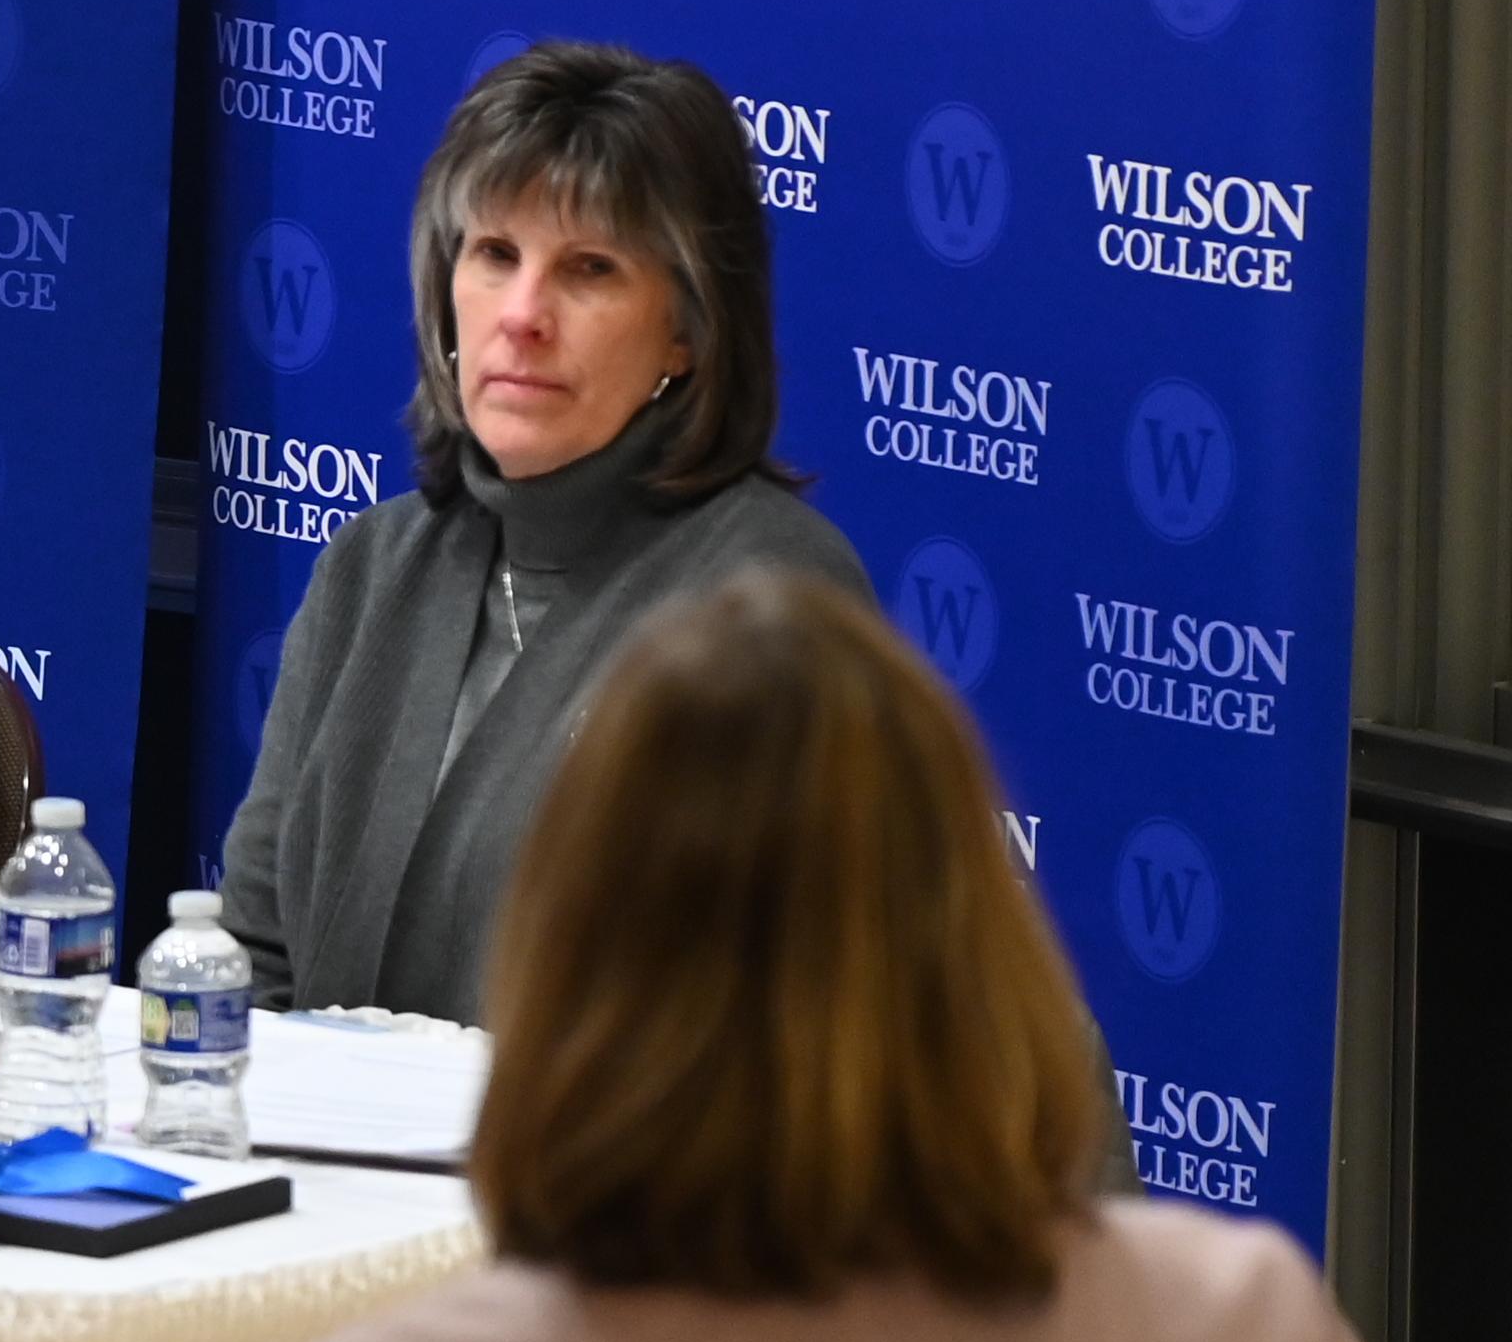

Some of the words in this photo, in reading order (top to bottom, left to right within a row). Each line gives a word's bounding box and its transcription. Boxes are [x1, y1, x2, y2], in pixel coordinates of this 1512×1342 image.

[216, 12, 388, 90] WILSON
[219, 73, 376, 139] COLLEGE
[1087, 154, 1312, 241] WILSON
[1099, 224, 1292, 292] COLLEGE
[853, 347, 1051, 435] WILSON
[209, 422, 382, 505] WILSON
[866, 416, 1038, 485] COLLEGE
[1076, 594, 1294, 684] WILSON
[1088, 663, 1275, 735] COLLEGE
